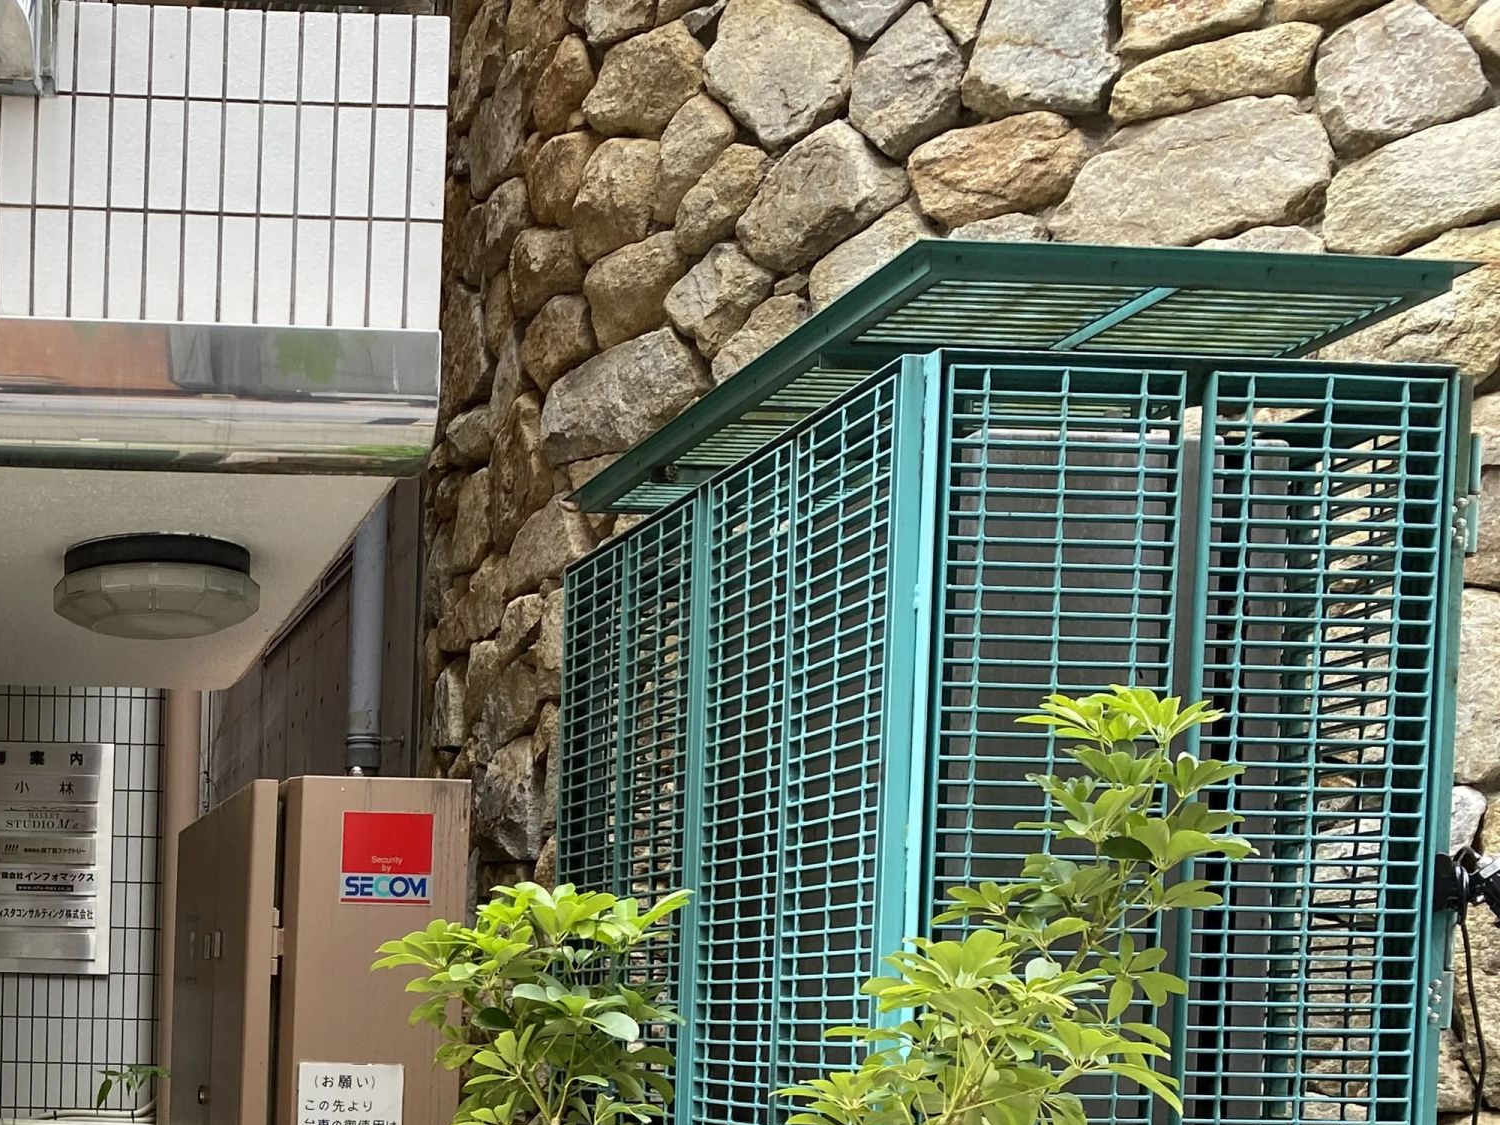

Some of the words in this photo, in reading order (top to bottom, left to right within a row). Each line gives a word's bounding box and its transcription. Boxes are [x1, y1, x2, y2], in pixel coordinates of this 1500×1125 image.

[14, 780, 75, 795] 小林
[28, 812, 60, 820] BALLET
[6, 819, 55, 829] STUDIO
[371, 855, 403, 866] Security
[381, 864, 392, 873] by
[345, 876, 427, 898] SECOM
[305, 1100, 373, 1113] この先より
